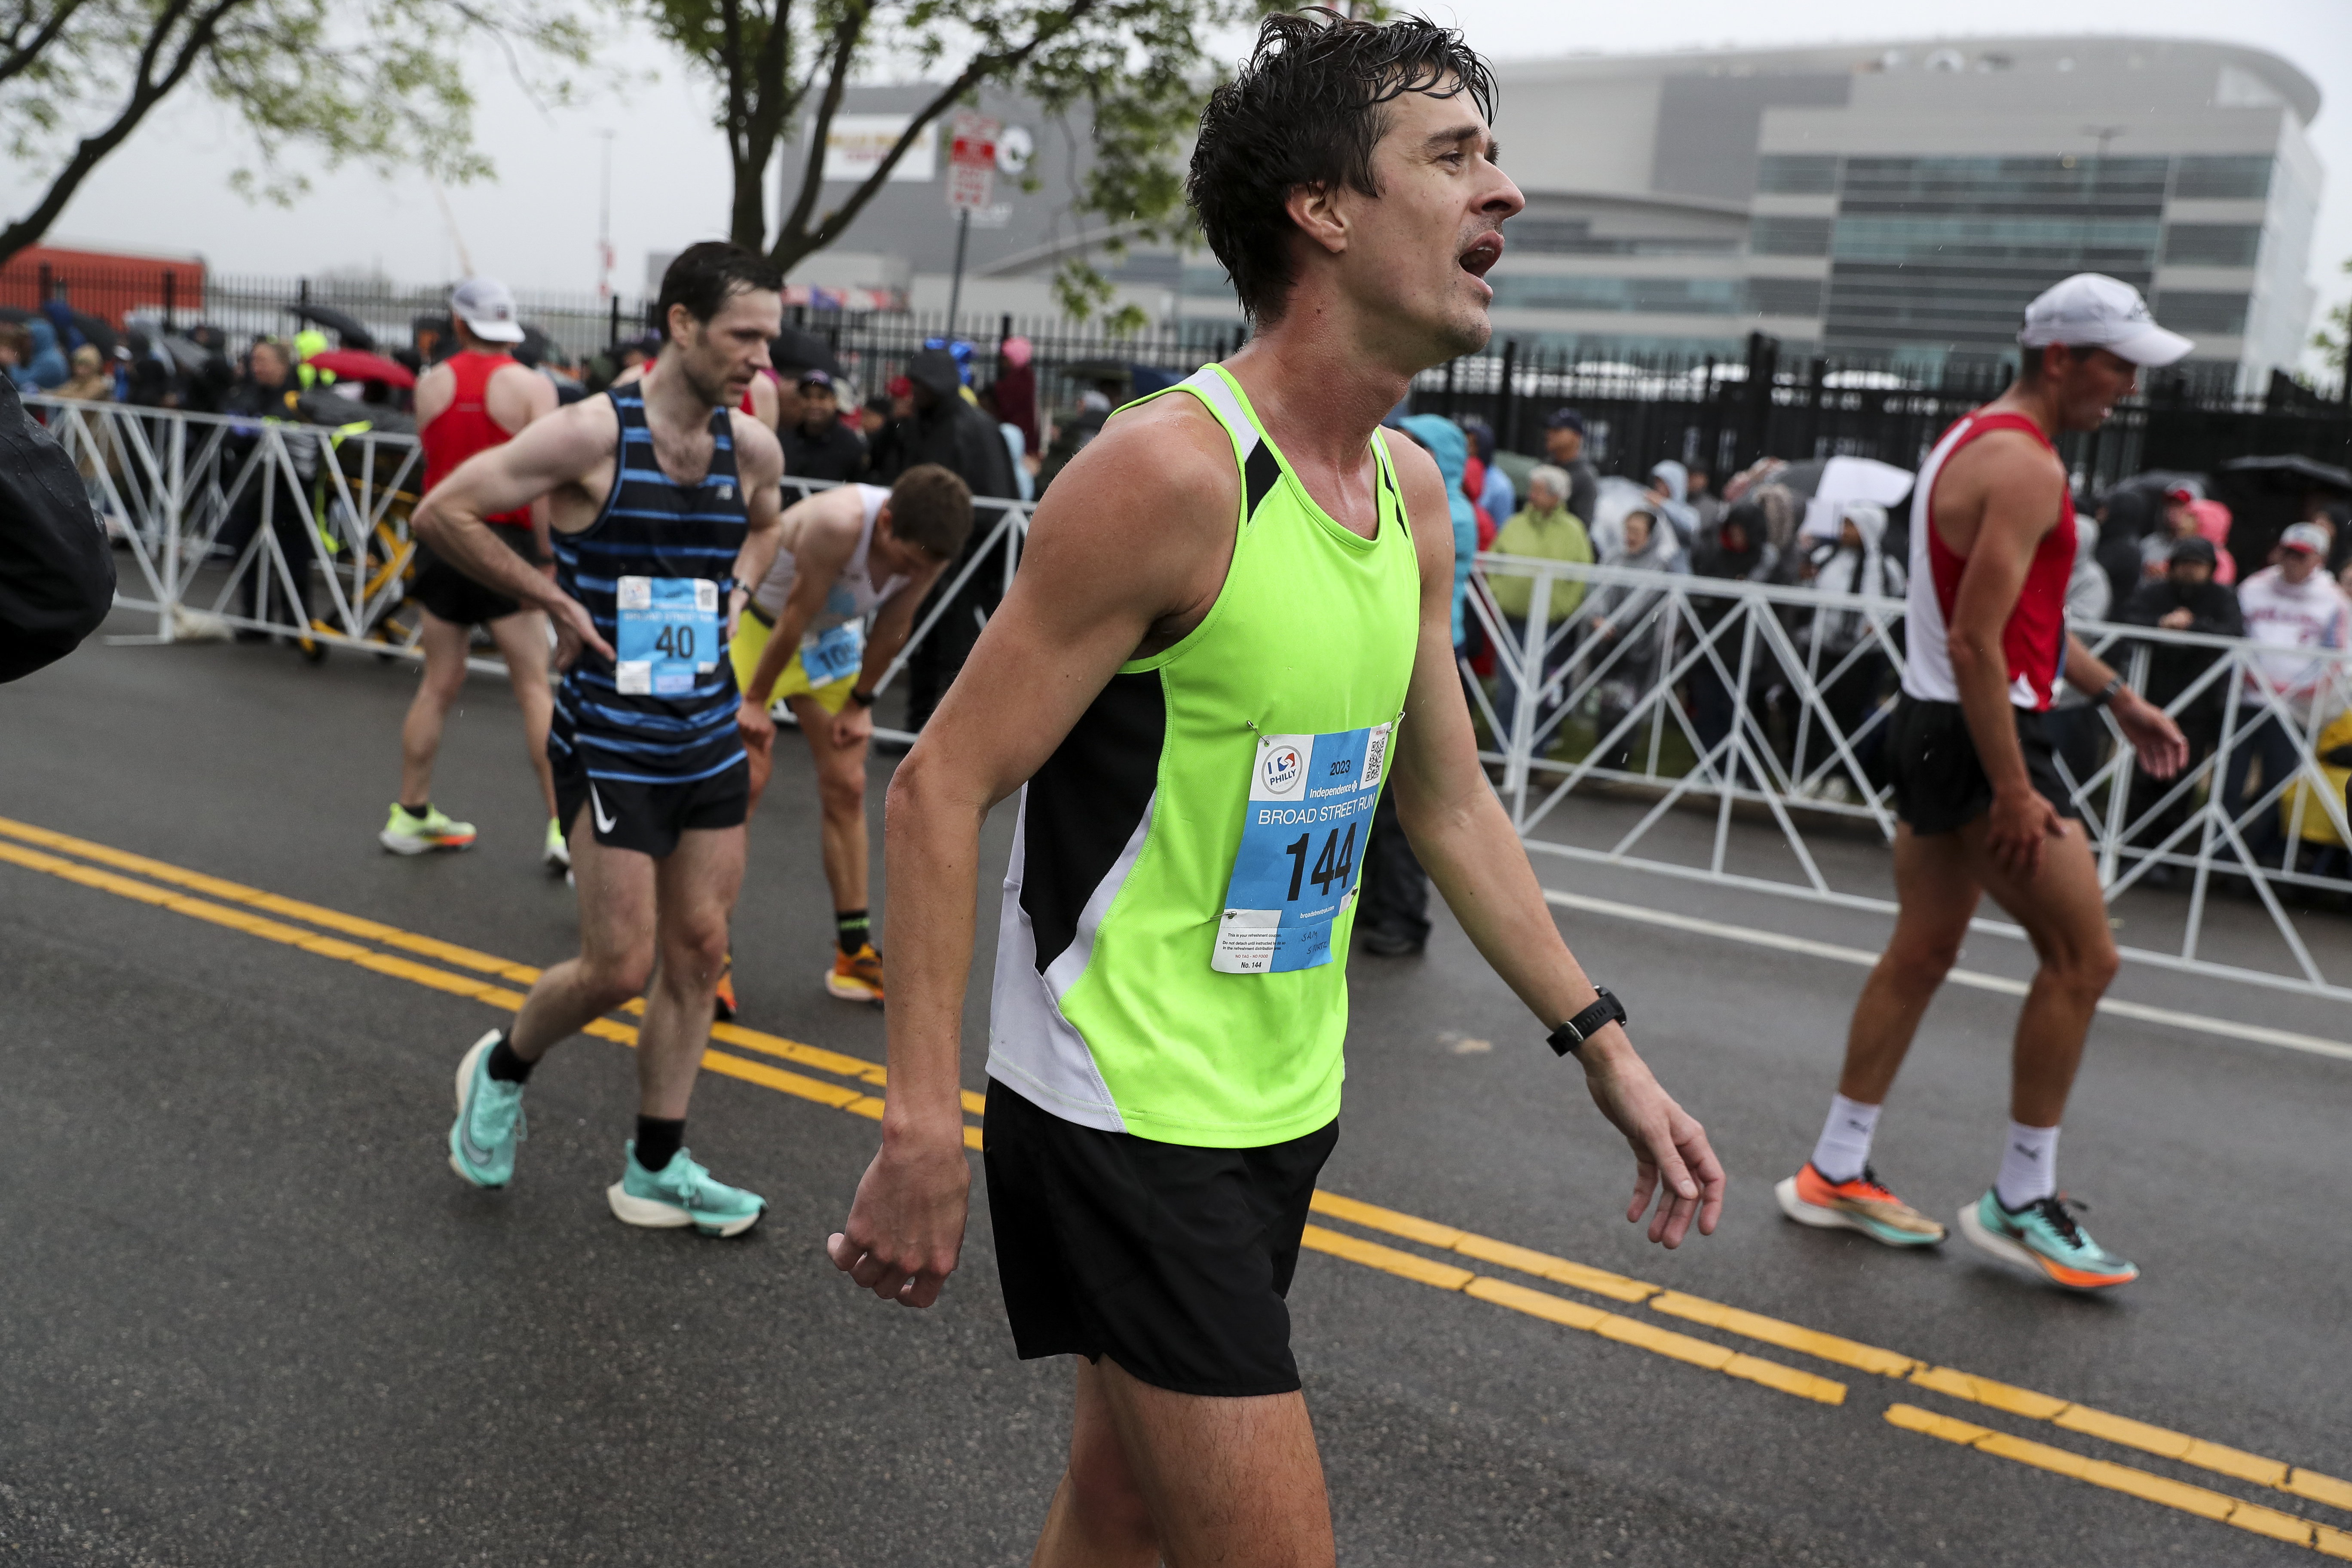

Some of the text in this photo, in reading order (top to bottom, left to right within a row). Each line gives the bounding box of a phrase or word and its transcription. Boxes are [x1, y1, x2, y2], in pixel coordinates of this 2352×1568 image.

[655, 625, 695, 658] 40
[1329, 759, 1351, 776] 2023
[1270, 768, 1297, 786] PHILLY
[1309, 783, 1351, 799] Independence
[1258, 792, 1376, 825] BROAD STREET RUN
[1286, 821, 1357, 901] 144
[1300, 905, 1335, 919] broadstreetrun.com
[1301, 931, 1317, 942] SAM
